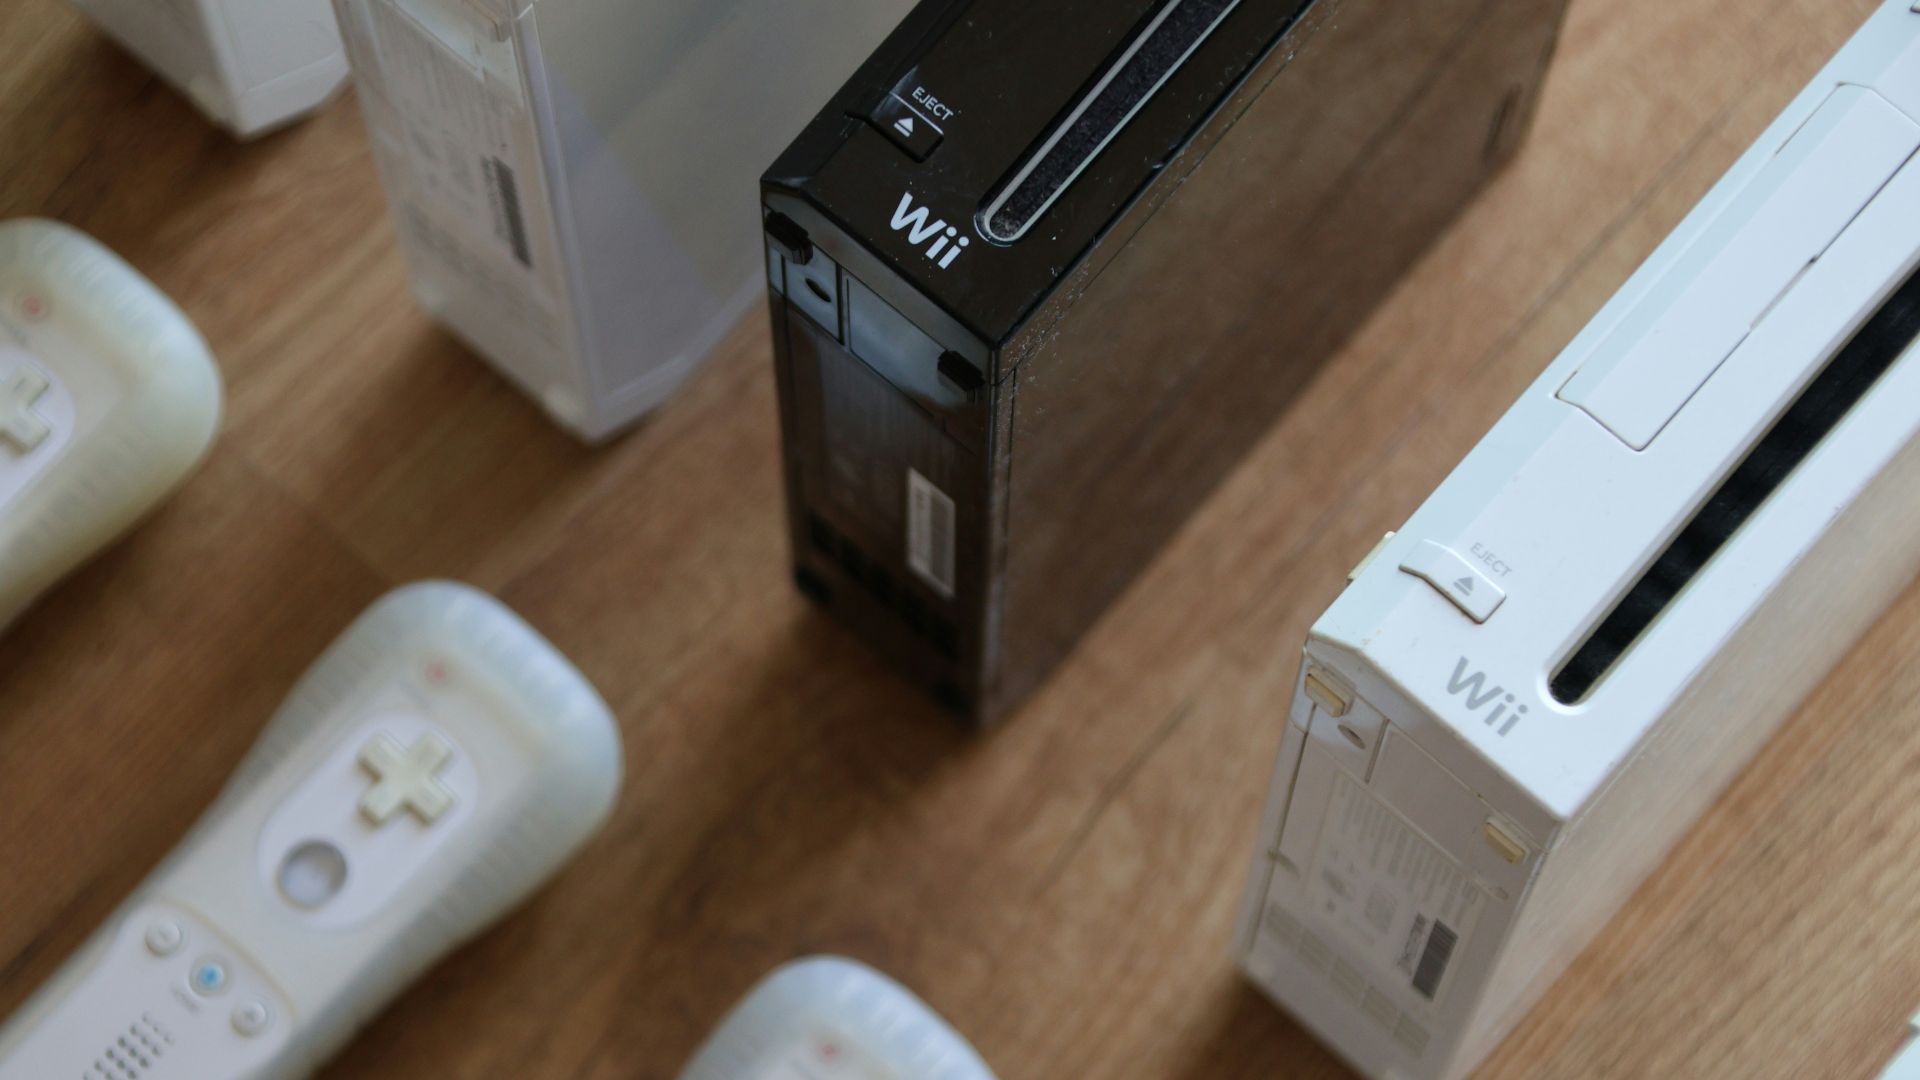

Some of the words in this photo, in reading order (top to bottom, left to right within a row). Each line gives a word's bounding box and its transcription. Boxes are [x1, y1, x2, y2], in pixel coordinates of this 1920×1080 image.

[912, 86, 954, 121] EJECT
[890, 191, 969, 269] Wii
[1470, 542, 1512, 577] EJECT
[1447, 656, 1528, 737] Wii
